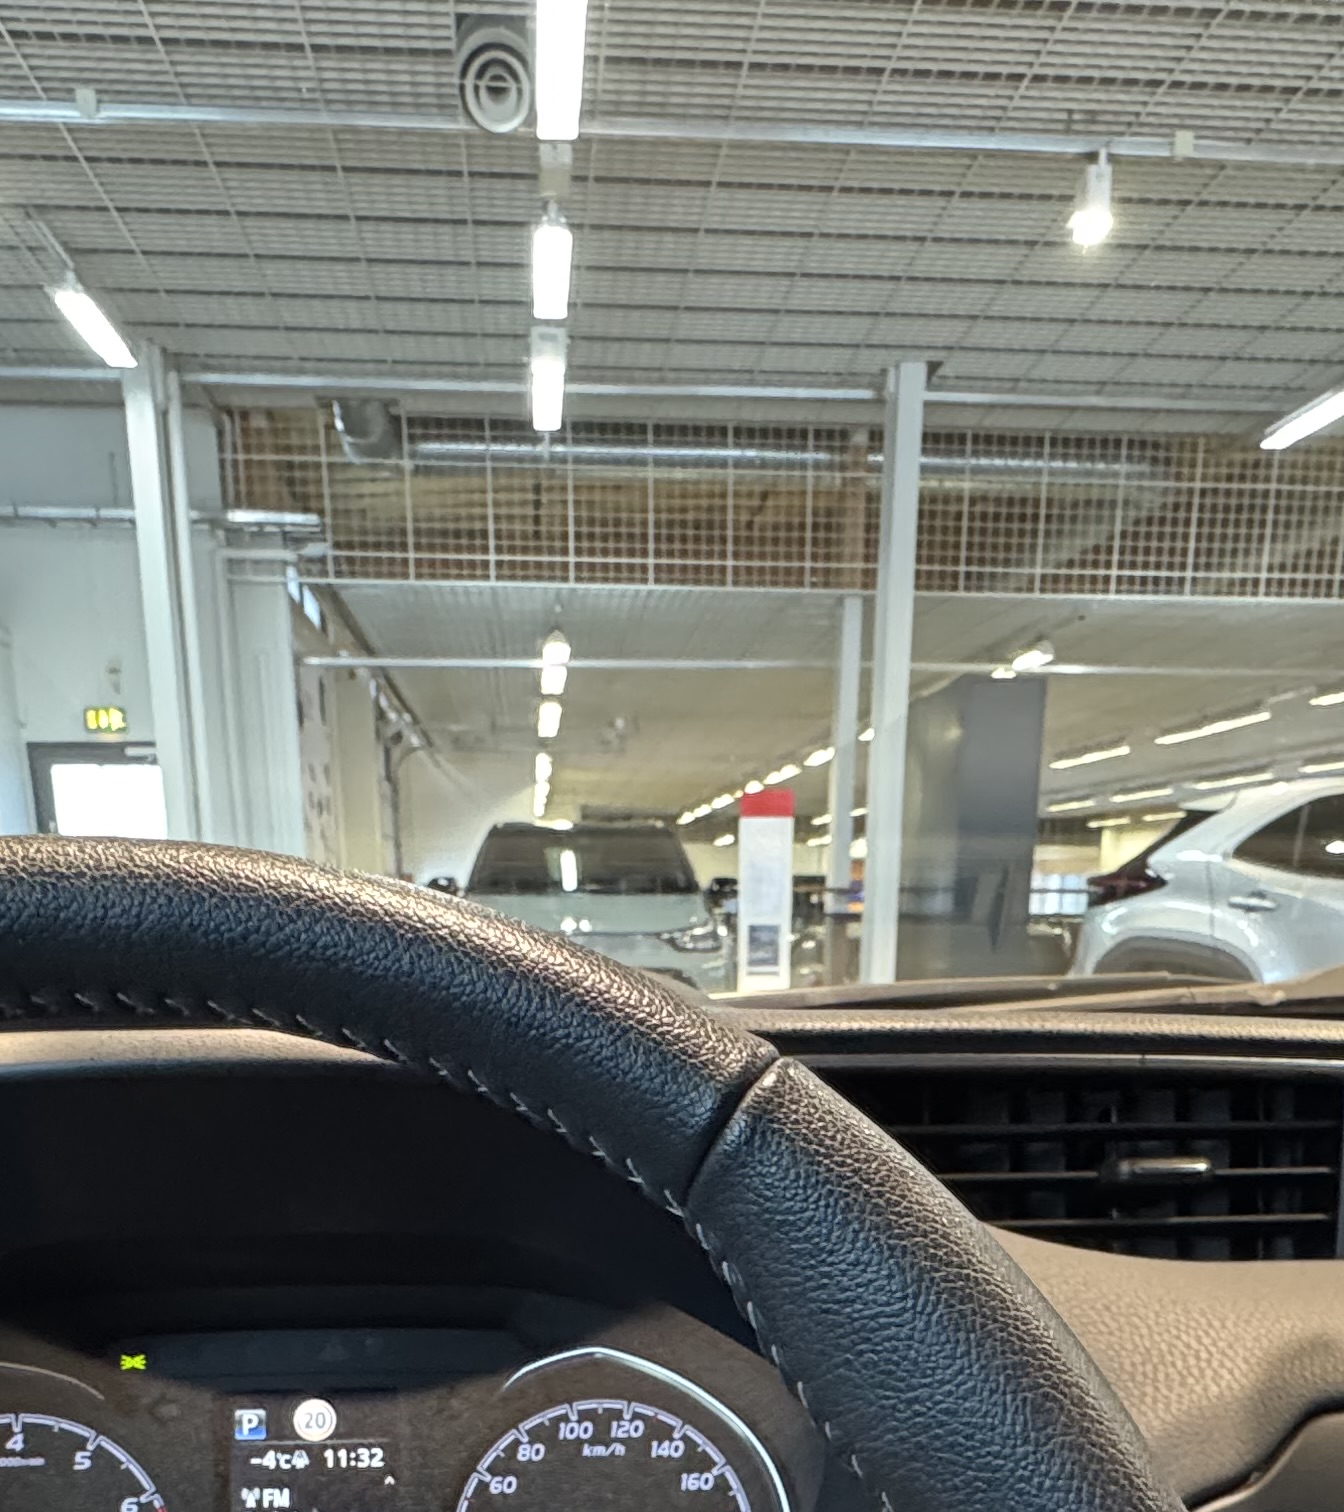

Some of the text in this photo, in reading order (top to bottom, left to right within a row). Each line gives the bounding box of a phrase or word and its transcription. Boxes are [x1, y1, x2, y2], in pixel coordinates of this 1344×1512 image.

[304, 1412, 326, 1429] 20
[558, 1420, 594, 1441] 100
[610, 1419, 645, 1439] 120
[5, 1433, 25, 1452] 4
[516, 1442, 546, 1462] 80
[582, 1442, 626, 1457] km/h
[650, 1440, 685, 1459] 140
[72, 1451, 92, 1471] 5
[324, 1447, 385, 1469] 11:32
[488, 1475, 518, 1495] 60
[680, 1472, 715, 1492] 160
[262, 1487, 290, 1508] FM
